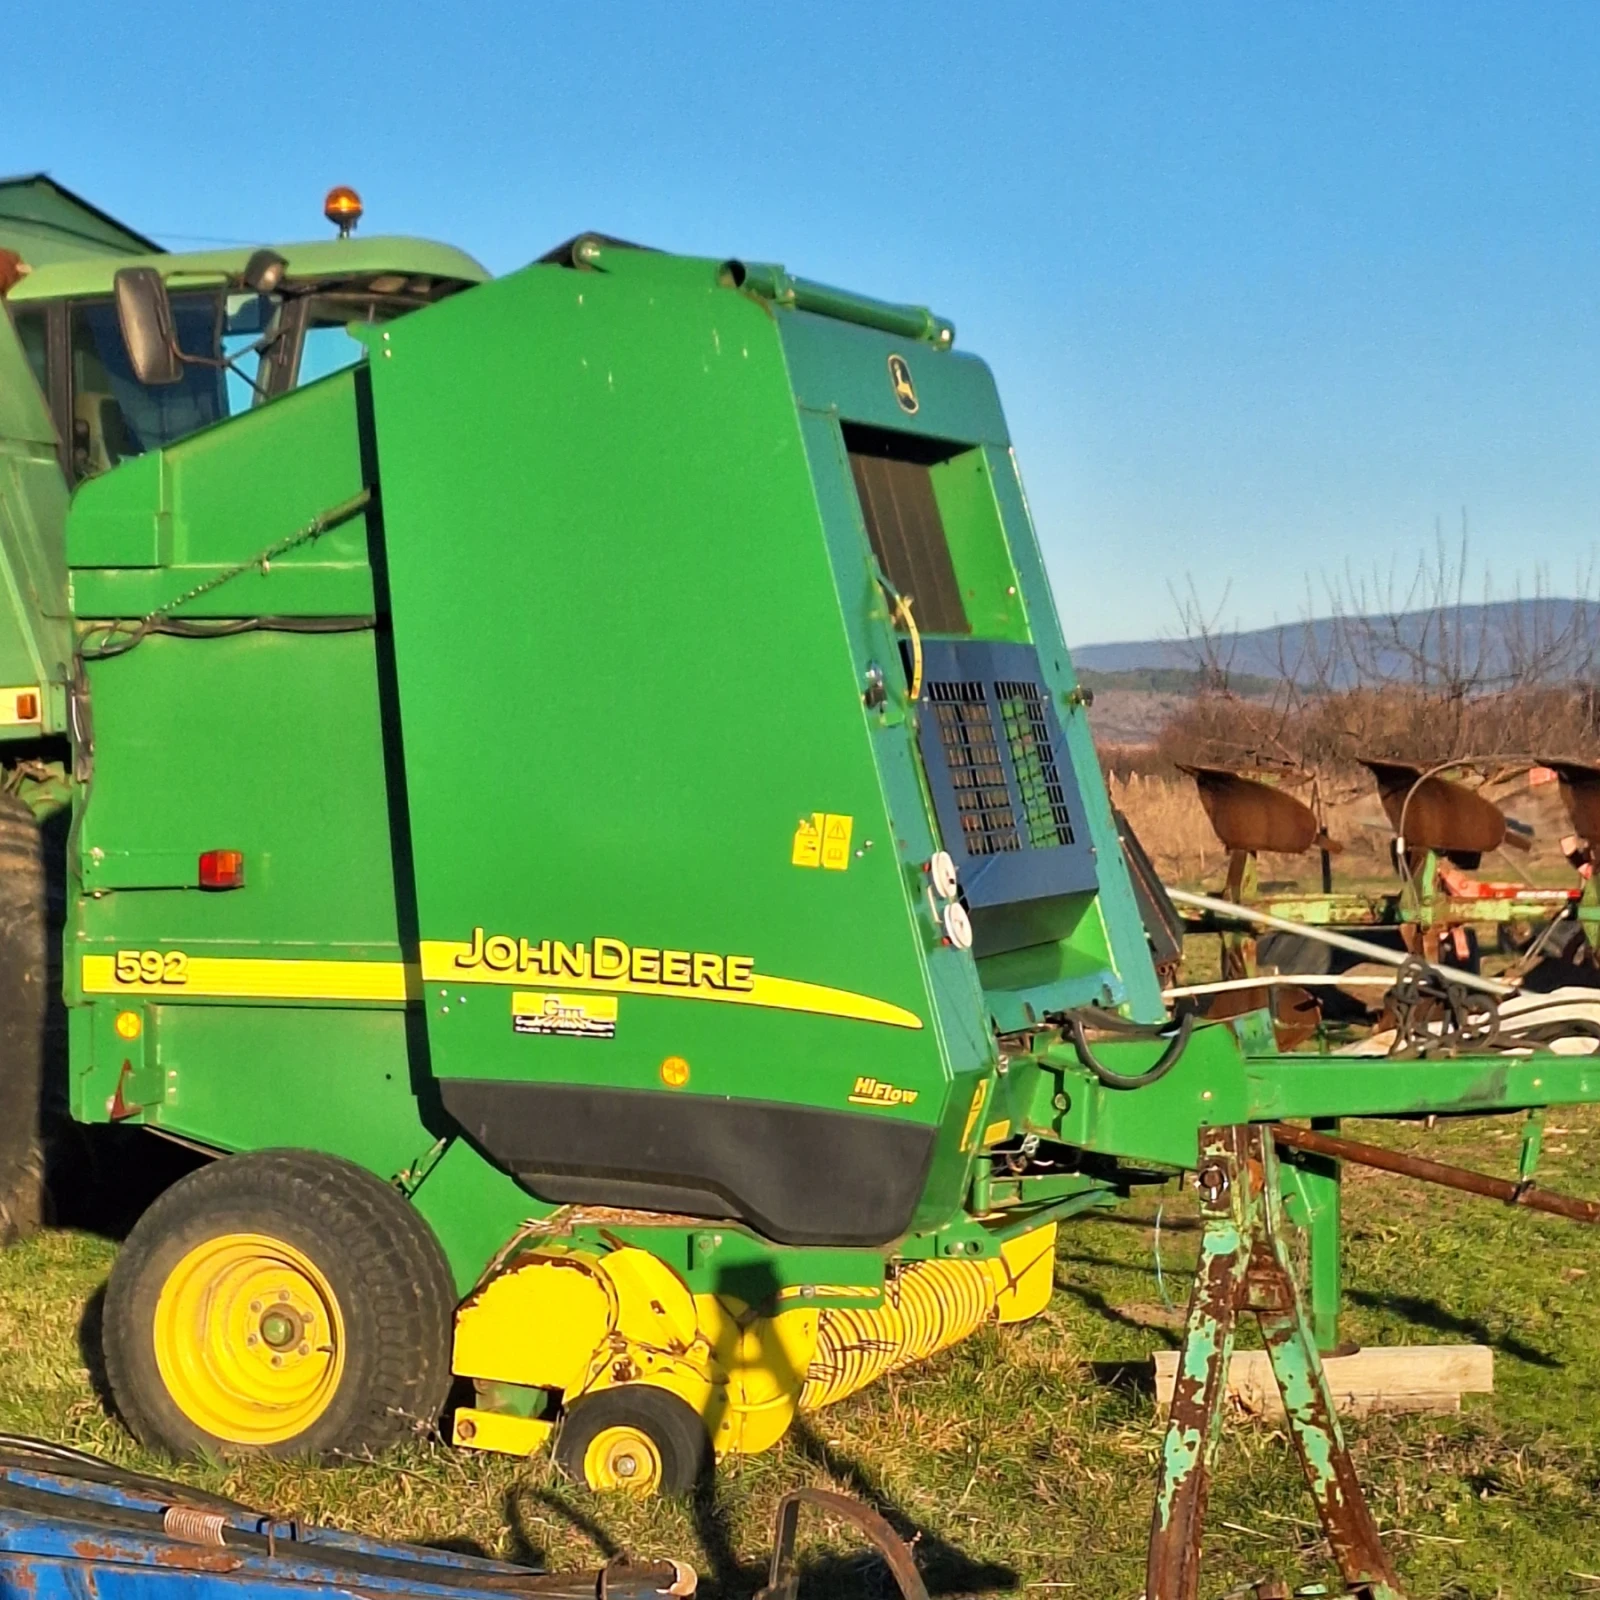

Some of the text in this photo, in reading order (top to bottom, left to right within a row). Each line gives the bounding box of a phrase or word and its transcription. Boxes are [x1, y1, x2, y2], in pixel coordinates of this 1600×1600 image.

[115, 950, 188, 984] 592
[455, 927, 754, 991] JOHN DEERE
